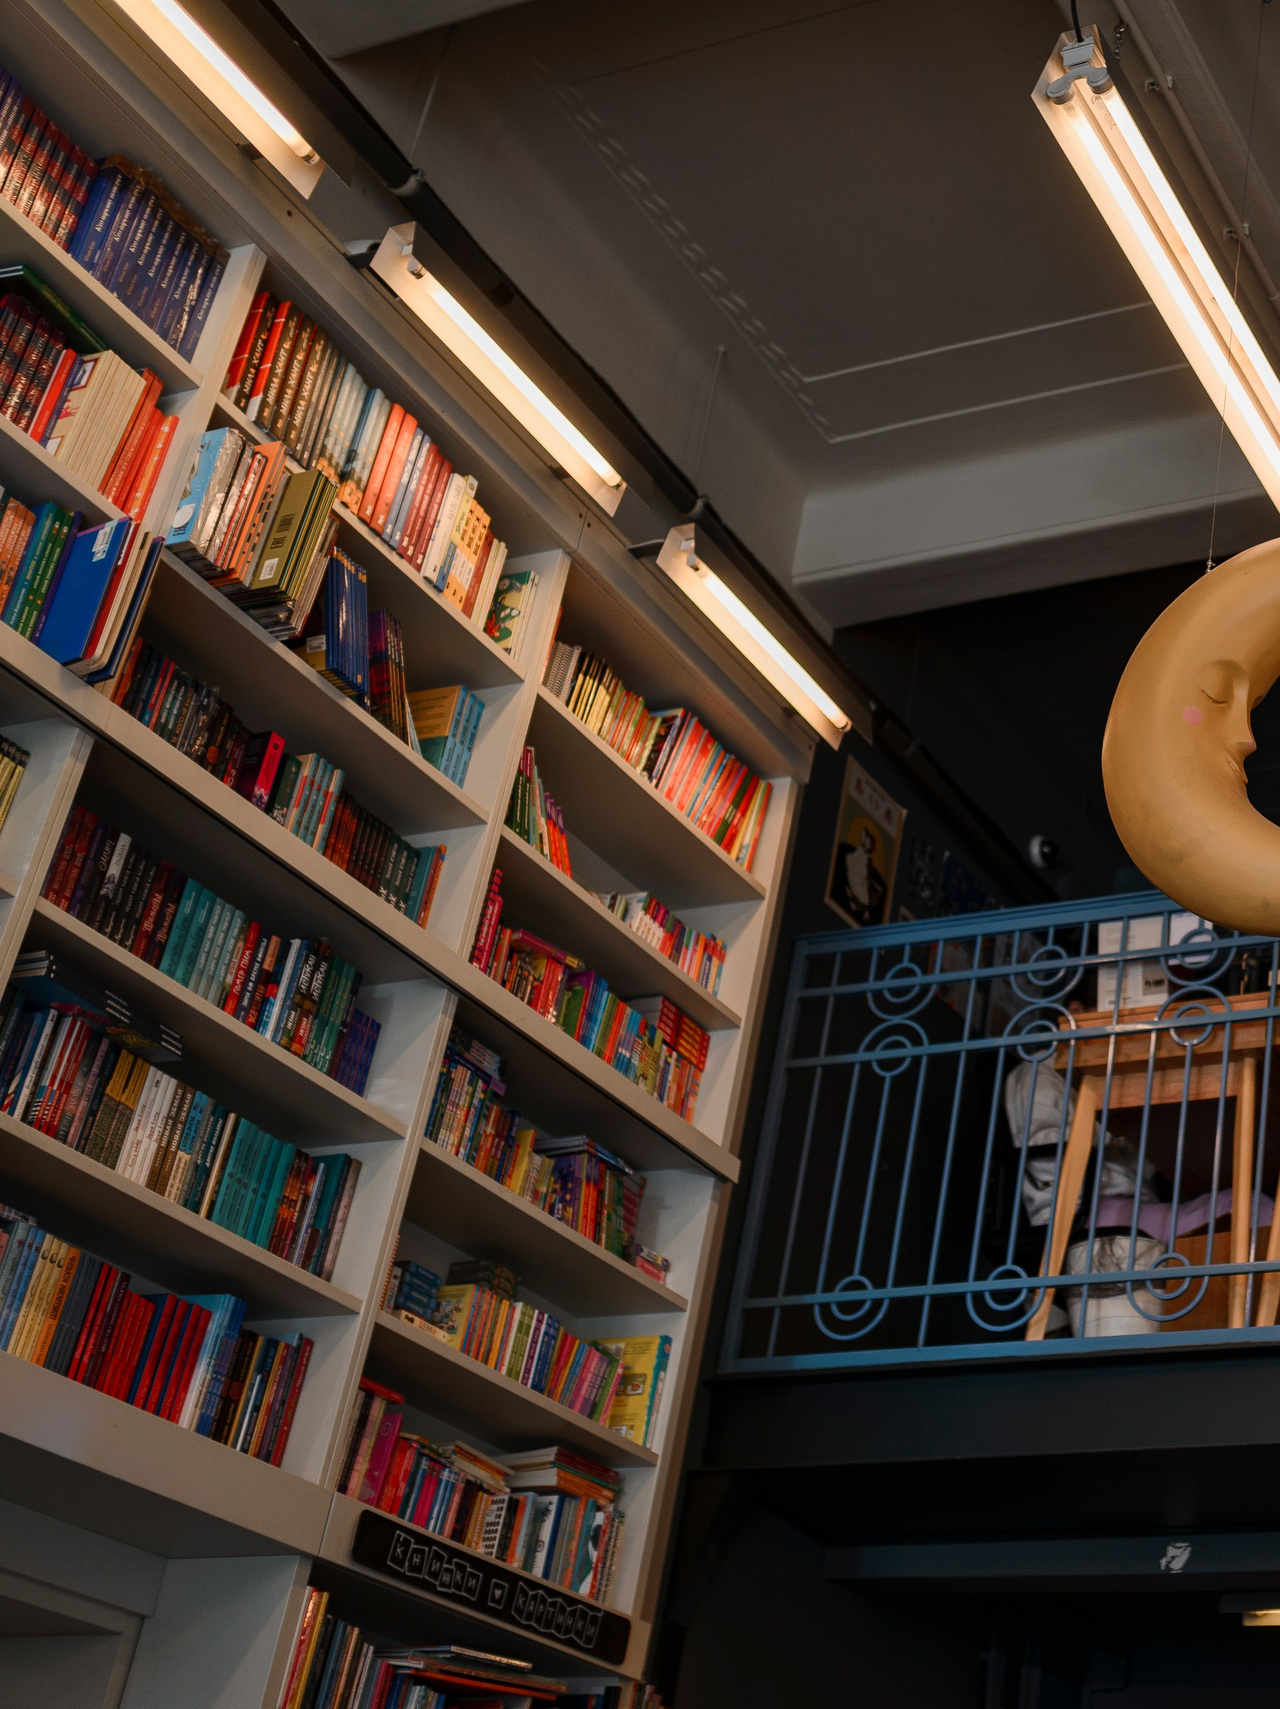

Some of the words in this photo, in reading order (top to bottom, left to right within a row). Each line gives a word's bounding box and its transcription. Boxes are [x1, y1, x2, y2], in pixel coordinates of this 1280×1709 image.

[243, 367, 256, 394] МИЛА
[252, 338, 264, 367] ХАНТ
[265, 376, 278, 404] МИЛА
[273, 347, 287, 376] ХАНТ
[279, 387, 292, 415] МИЛА
[288, 358, 300, 387] ХАНТ
[292, 399, 306, 427] МИЛА
[301, 371, 314, 399] ХАНТ
[233, 968, 245, 995] ГОМЕР
[240, 948, 252, 969] ПИМ
[297, 953, 316, 994] ИСТУКАН
[309, 960, 327, 1001] ИСТУКАН
[161, 1119, 172, 1147] НОВАЯ
[170, 1088, 182, 1117] ЗЕМЛЯ
[170, 1123, 182, 1151] НОВАЯ
[180, 1093, 191, 1122] ЗЕМЛЯ
[49, 1284, 66, 1320] ШИШКИН
[62, 1255, 76, 1283] КОРЕНЬ
[393, 1541, 477, 1592] КНИЖКИ
[516, 1595, 597, 1638] КАРТИНКИ
